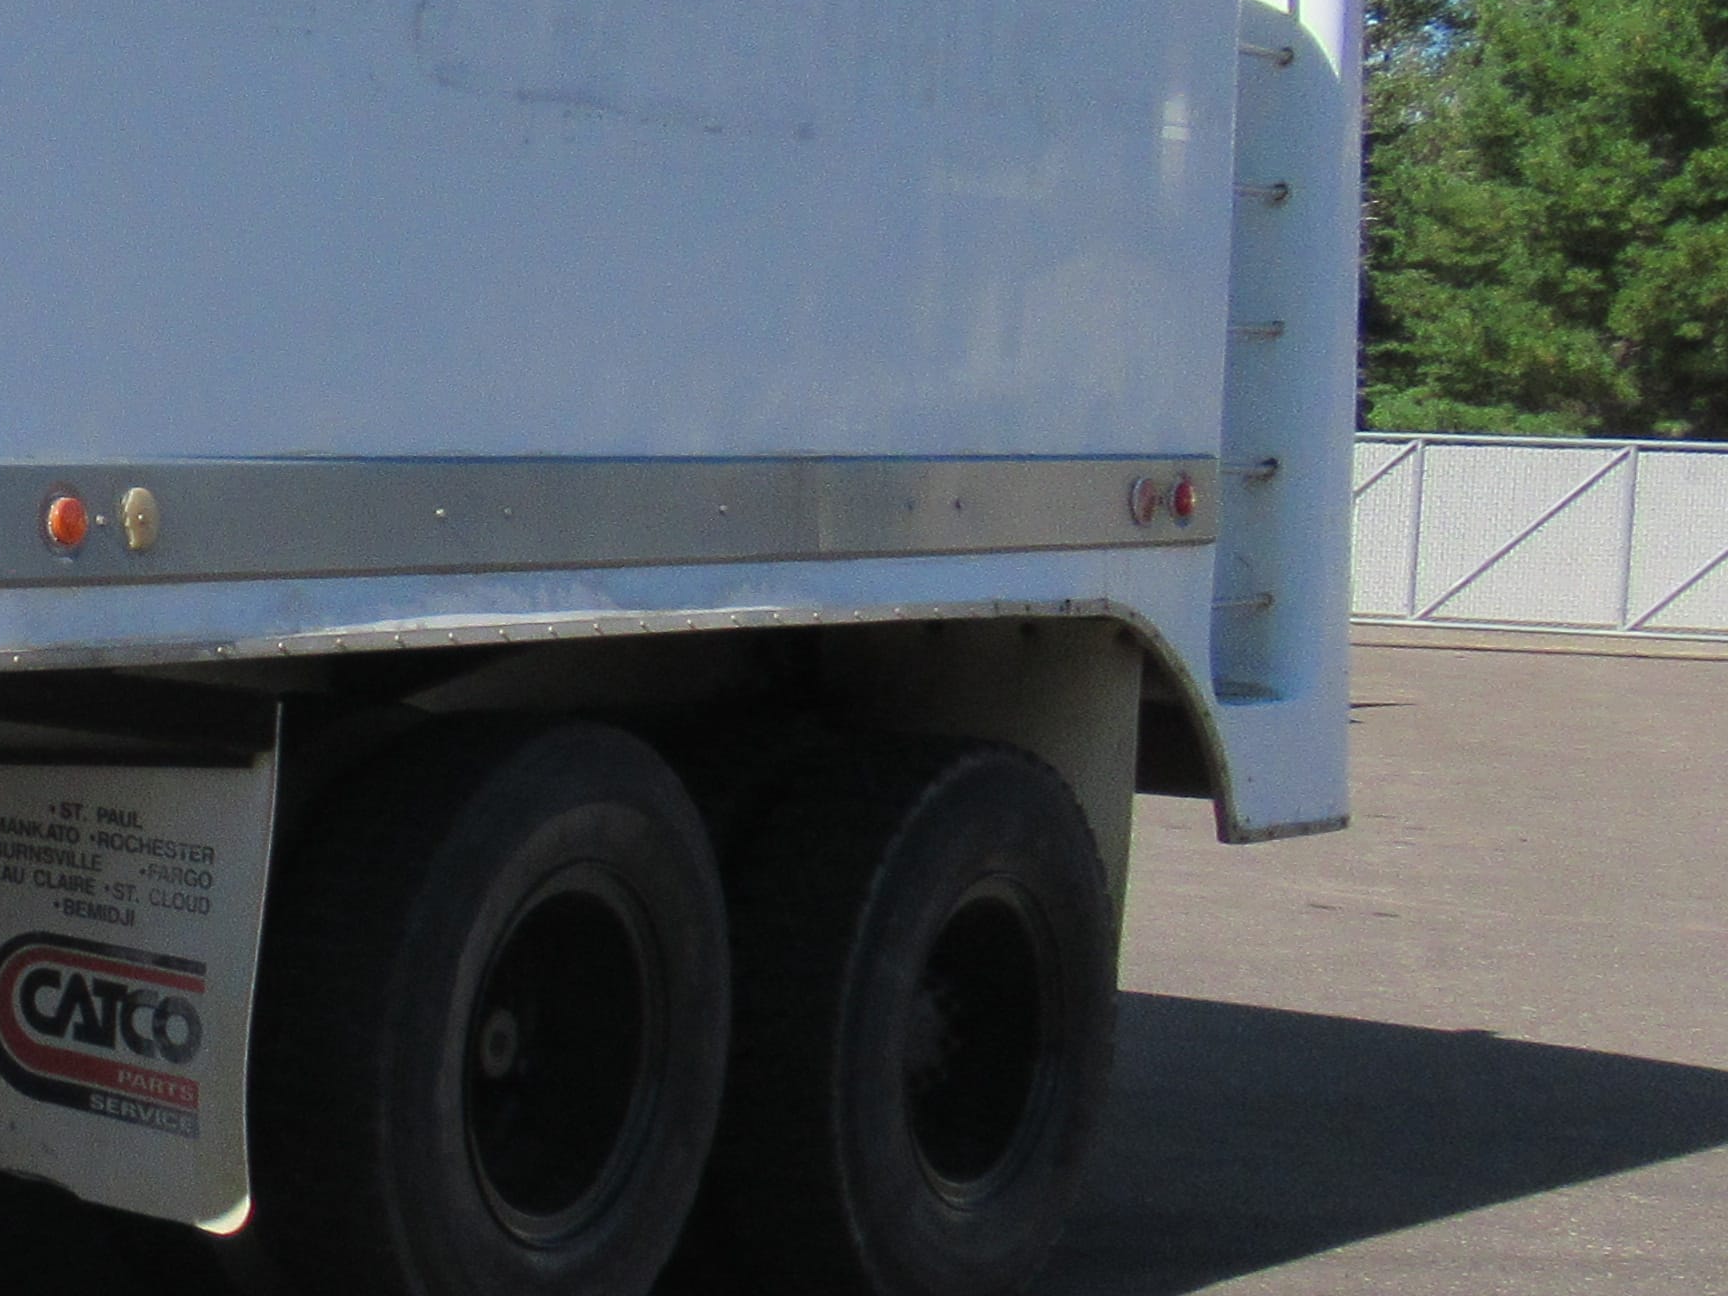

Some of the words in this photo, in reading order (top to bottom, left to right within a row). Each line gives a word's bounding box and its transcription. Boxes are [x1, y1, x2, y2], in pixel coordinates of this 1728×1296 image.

[97, 807, 143, 830] PAUL
[97, 830, 215, 865] ROCHESTER
[33, 869, 96, 896] CLAIRE
[149, 888, 210, 915] CLOUD
[147, 862, 213, 889] FARGO
[63, 898, 135, 927] BEMIDJI
[21, 968, 203, 1064] CATCO
[118, 1070, 196, 1102] PARTS
[89, 1093, 194, 1132] SERVICE
